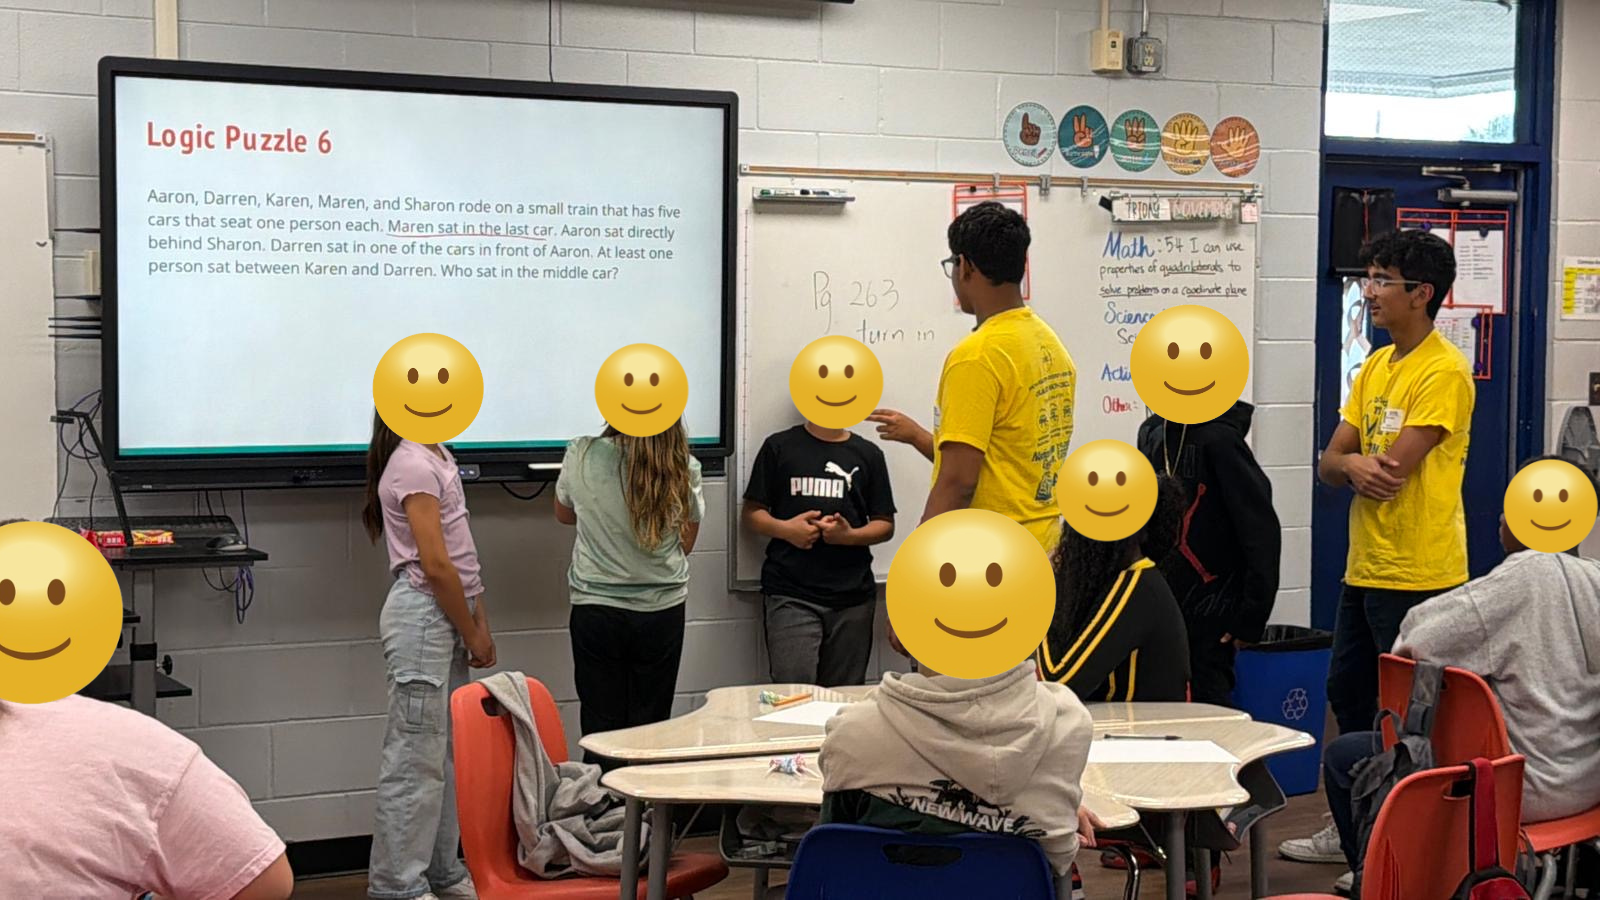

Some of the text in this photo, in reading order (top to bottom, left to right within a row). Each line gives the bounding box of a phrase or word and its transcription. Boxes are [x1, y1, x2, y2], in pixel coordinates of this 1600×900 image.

[147, 121, 332, 154] Logic Puzzle 6
[147, 189, 681, 218] Aaron, Darren, Karen, Maren, and Sharon rode on a small train that has five
[148, 214, 675, 242] cars that seat one person each. Maren sat in the last car. Aaron sat directly
[149, 235, 673, 259] behind Sharon. Darren sat in one of the cars in front of Aaron. At least one
[1190, 237, 1200, 252] I
[1203, 242, 1221, 253] can
[1226, 242, 1244, 252] use
[149, 259, 619, 280] person sat between Karen and Darren. Who sat in the middle car?
[1100, 261, 1145, 280] properties
[1148, 260, 1159, 274] of
[1228, 262, 1242, 272] to
[813, 271, 899, 334] Pg 263
[1100, 283, 1122, 296] solve
[1126, 283, 1160, 297] problems
[1161, 285, 1171, 295] on
[1172, 287, 1179, 295] a
[1225, 283, 1248, 298] plane
[856, 319, 935, 344] turn in
[790, 477, 844, 498] PUMA
[910, 799, 1015, 832] NEW WAVE
